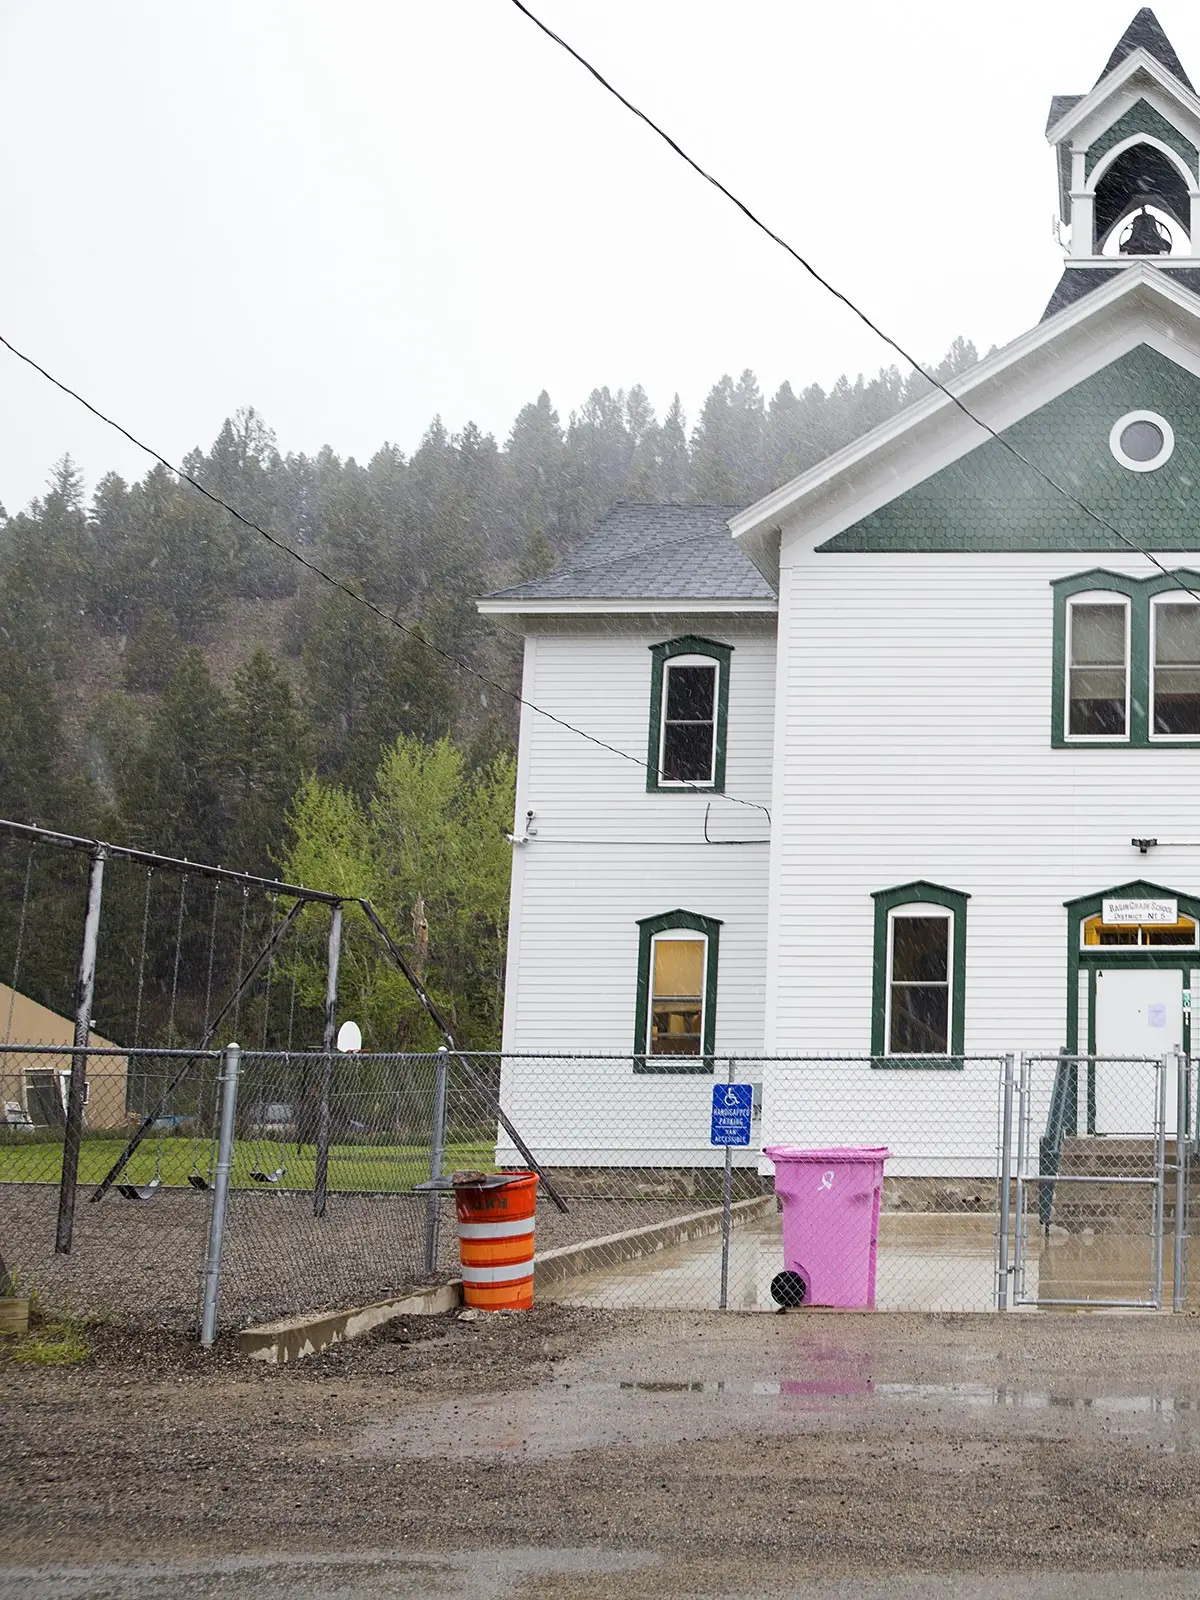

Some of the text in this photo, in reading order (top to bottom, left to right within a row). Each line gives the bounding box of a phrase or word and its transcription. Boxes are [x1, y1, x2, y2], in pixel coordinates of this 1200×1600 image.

[1109, 904, 1129, 913] BASIN
[1151, 902, 1173, 914] SCHOOL
[720, 1117, 743, 1125] PARKING
